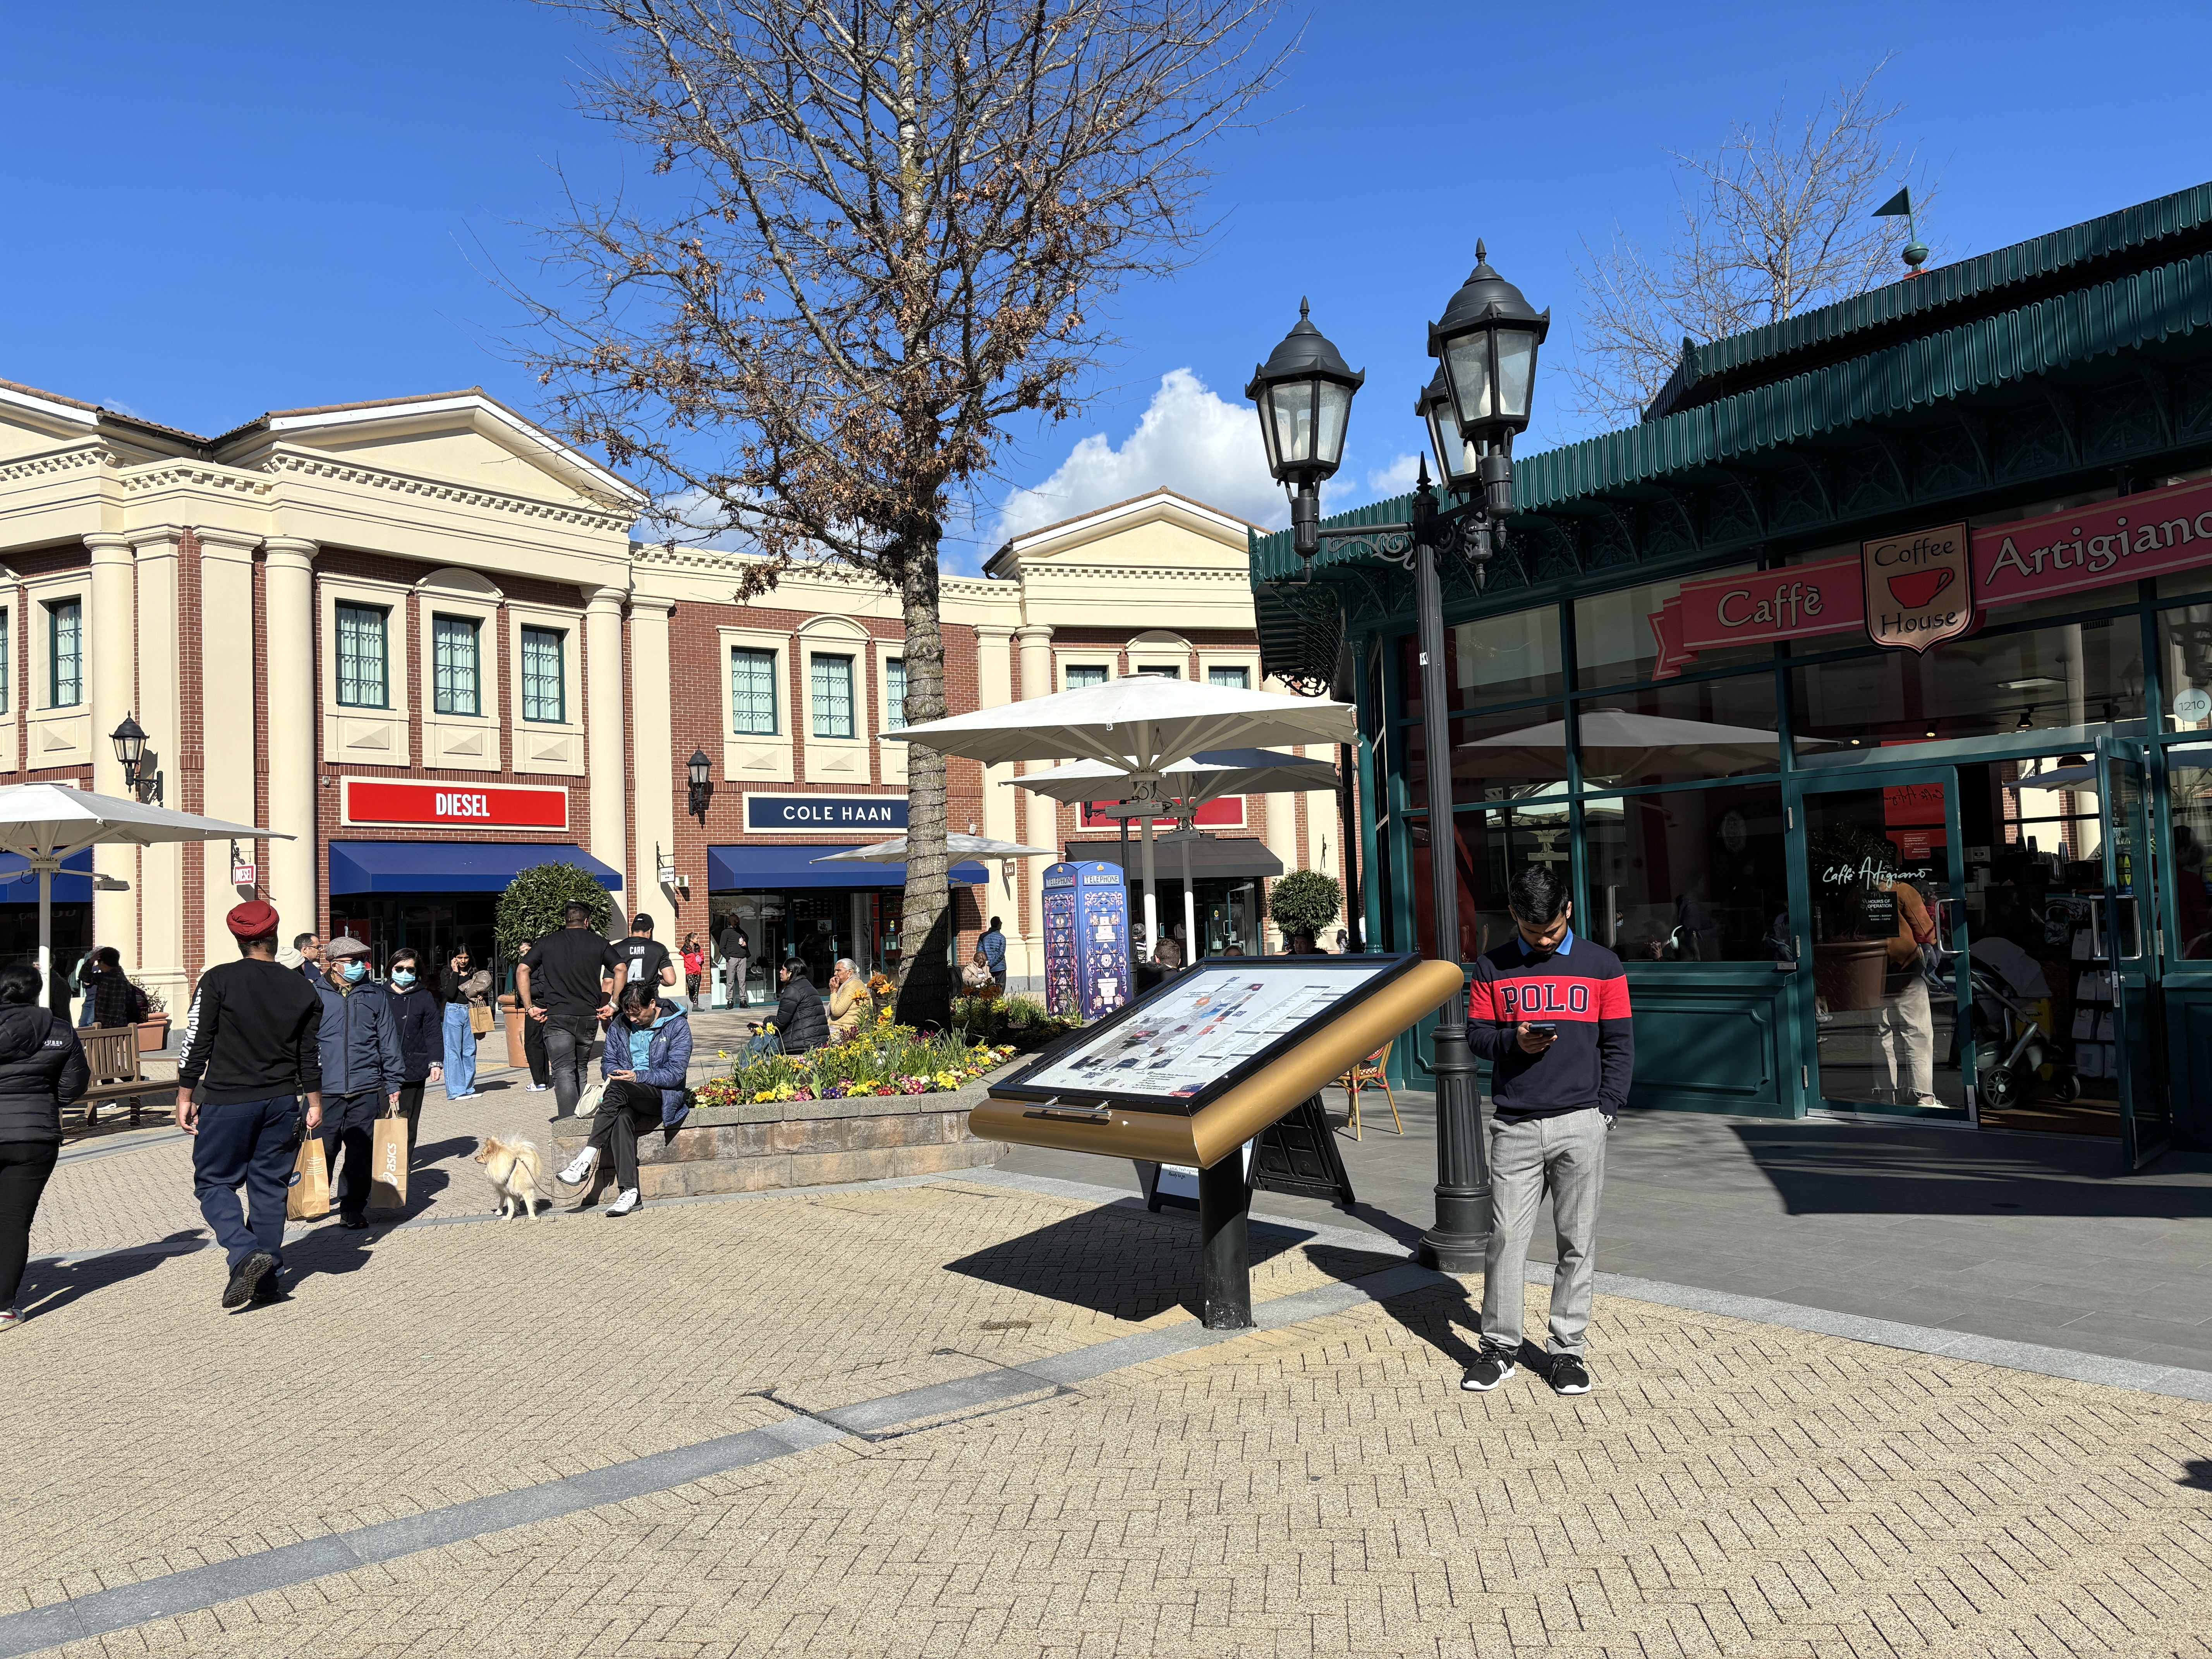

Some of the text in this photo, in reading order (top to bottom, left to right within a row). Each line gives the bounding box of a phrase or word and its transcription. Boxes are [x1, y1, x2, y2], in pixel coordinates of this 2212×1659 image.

[1874, 538, 1955, 565] Coffee
[1717, 582, 1823, 629] Caffè
[1881, 612, 1958, 637] House
[2179, 700, 2205, 711] 1210
[436, 793, 490, 817] DIESEL
[783, 806, 891, 820] COLE HAAN
[235, 867, 252, 882] DIESEL
[1047, 876, 1073, 886] TELEPHONE
[630, 946, 645, 955] CARR
[627, 958, 645, 983] 4
[1500, 984, 1589, 1014] POLO
[386, 1142, 397, 1171] asics
